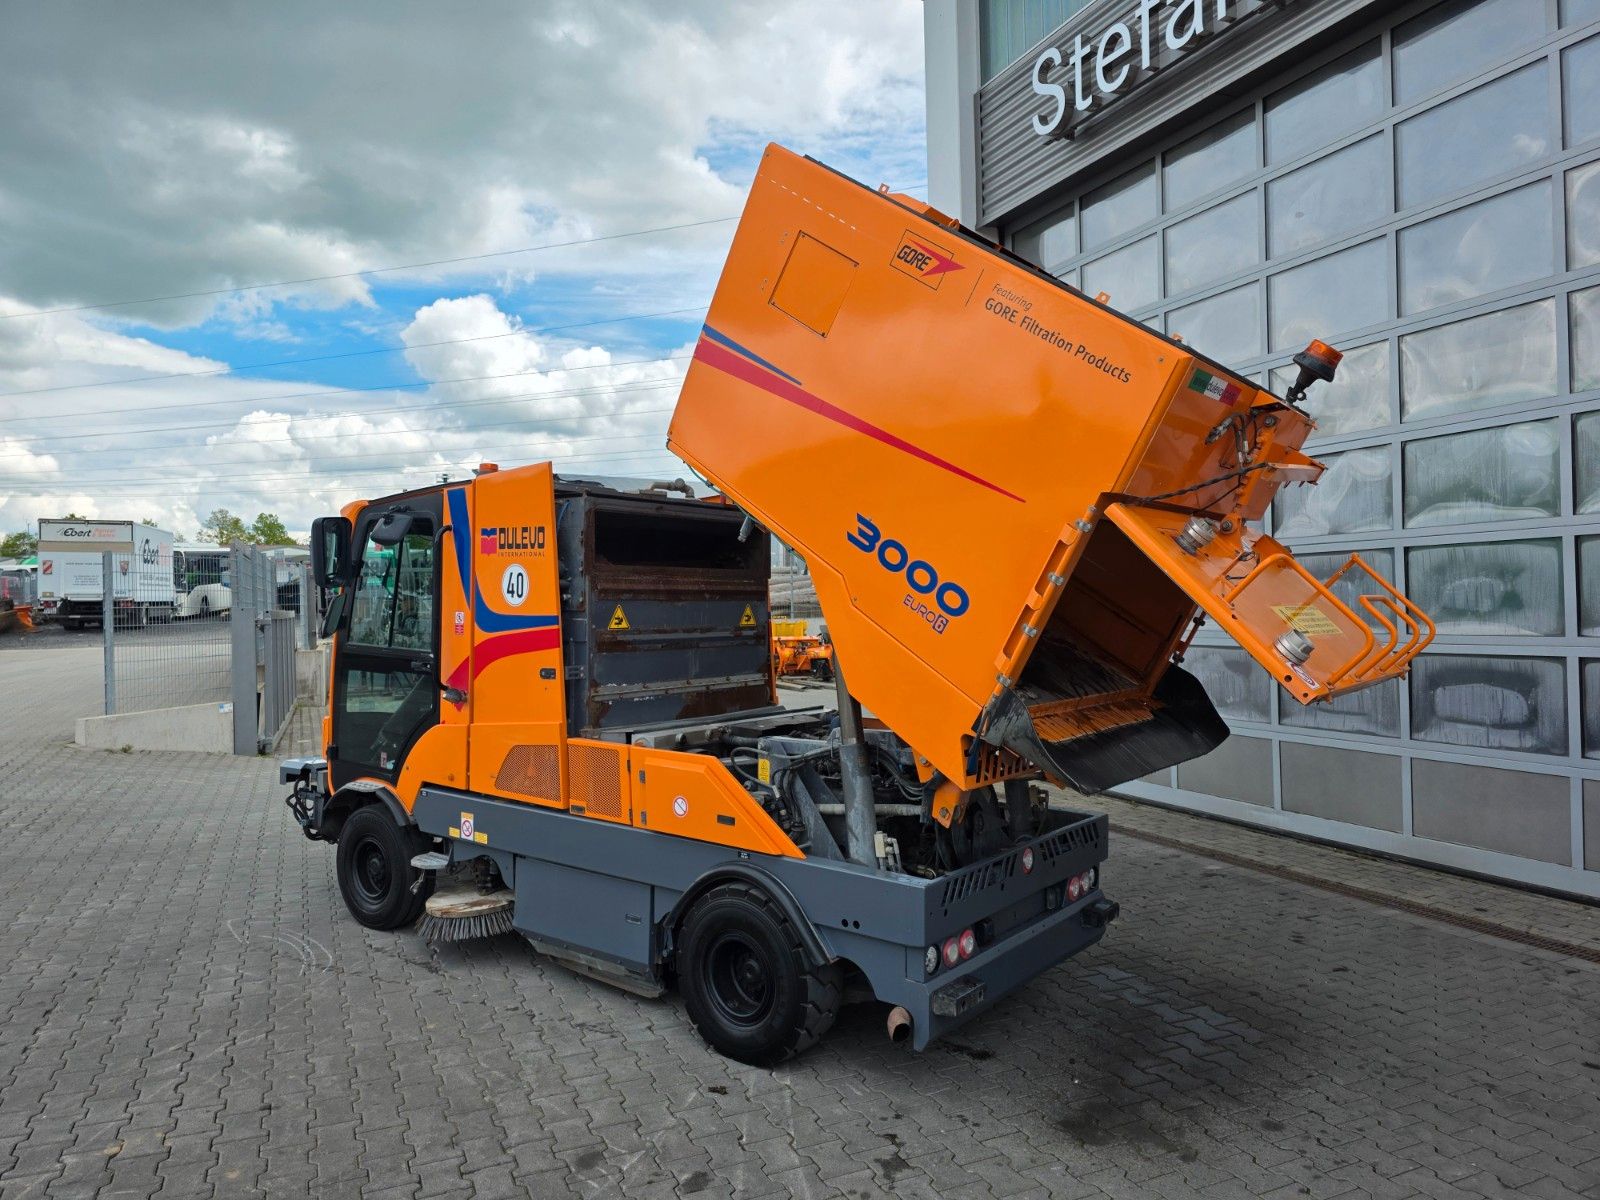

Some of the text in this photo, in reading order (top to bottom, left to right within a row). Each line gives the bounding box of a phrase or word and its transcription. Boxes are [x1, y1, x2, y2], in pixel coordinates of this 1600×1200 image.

[1032, 0, 1227, 135] Stefa
[896, 244, 932, 272] GORE
[992, 283, 1033, 311] Featuring
[985, 297, 1132, 384] GORE Filtration Products
[498, 526, 545, 549] DULEVO
[846, 512, 970, 617] 3000
[506, 572, 524, 598] 40
